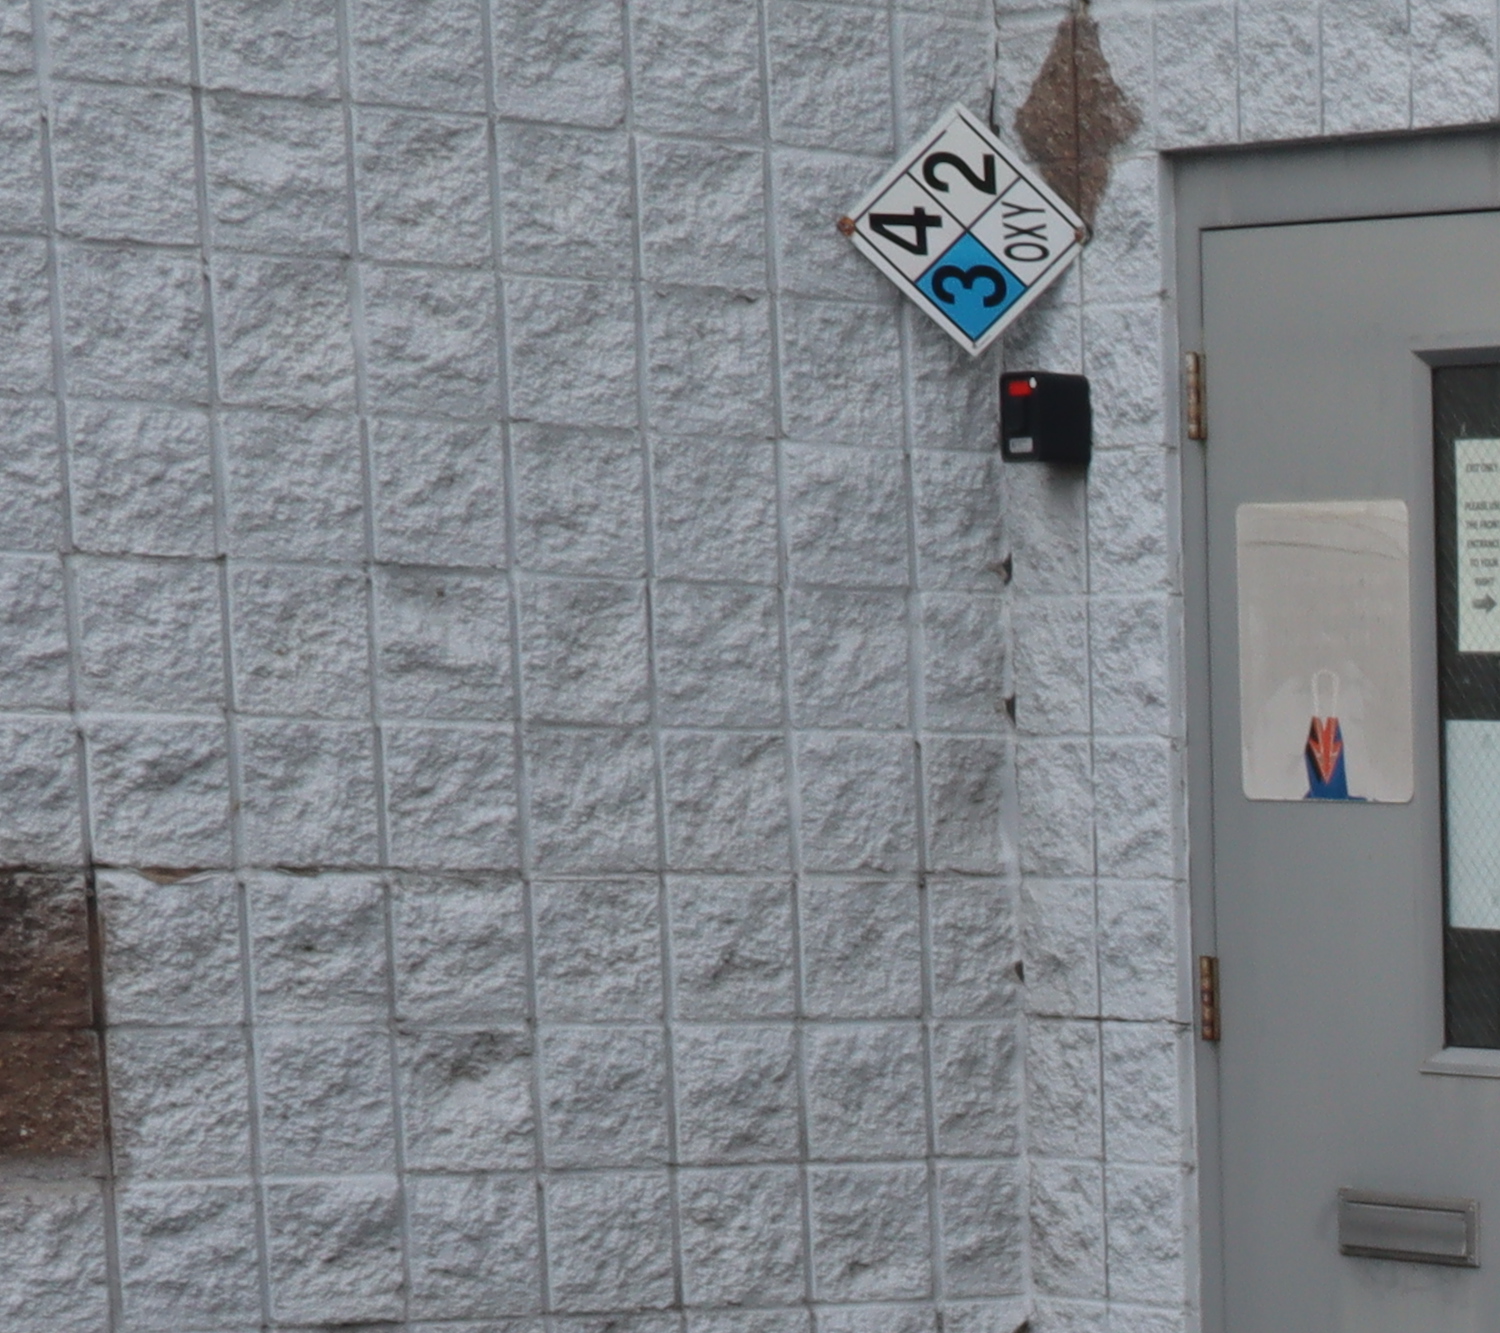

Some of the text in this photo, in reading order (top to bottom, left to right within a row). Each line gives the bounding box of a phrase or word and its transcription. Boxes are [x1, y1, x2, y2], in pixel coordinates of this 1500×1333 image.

[922, 151, 998, 196] 2
[868, 206, 943, 256] 4
[1001, 201, 1050, 262] OXY
[931, 264, 1007, 308] 3
